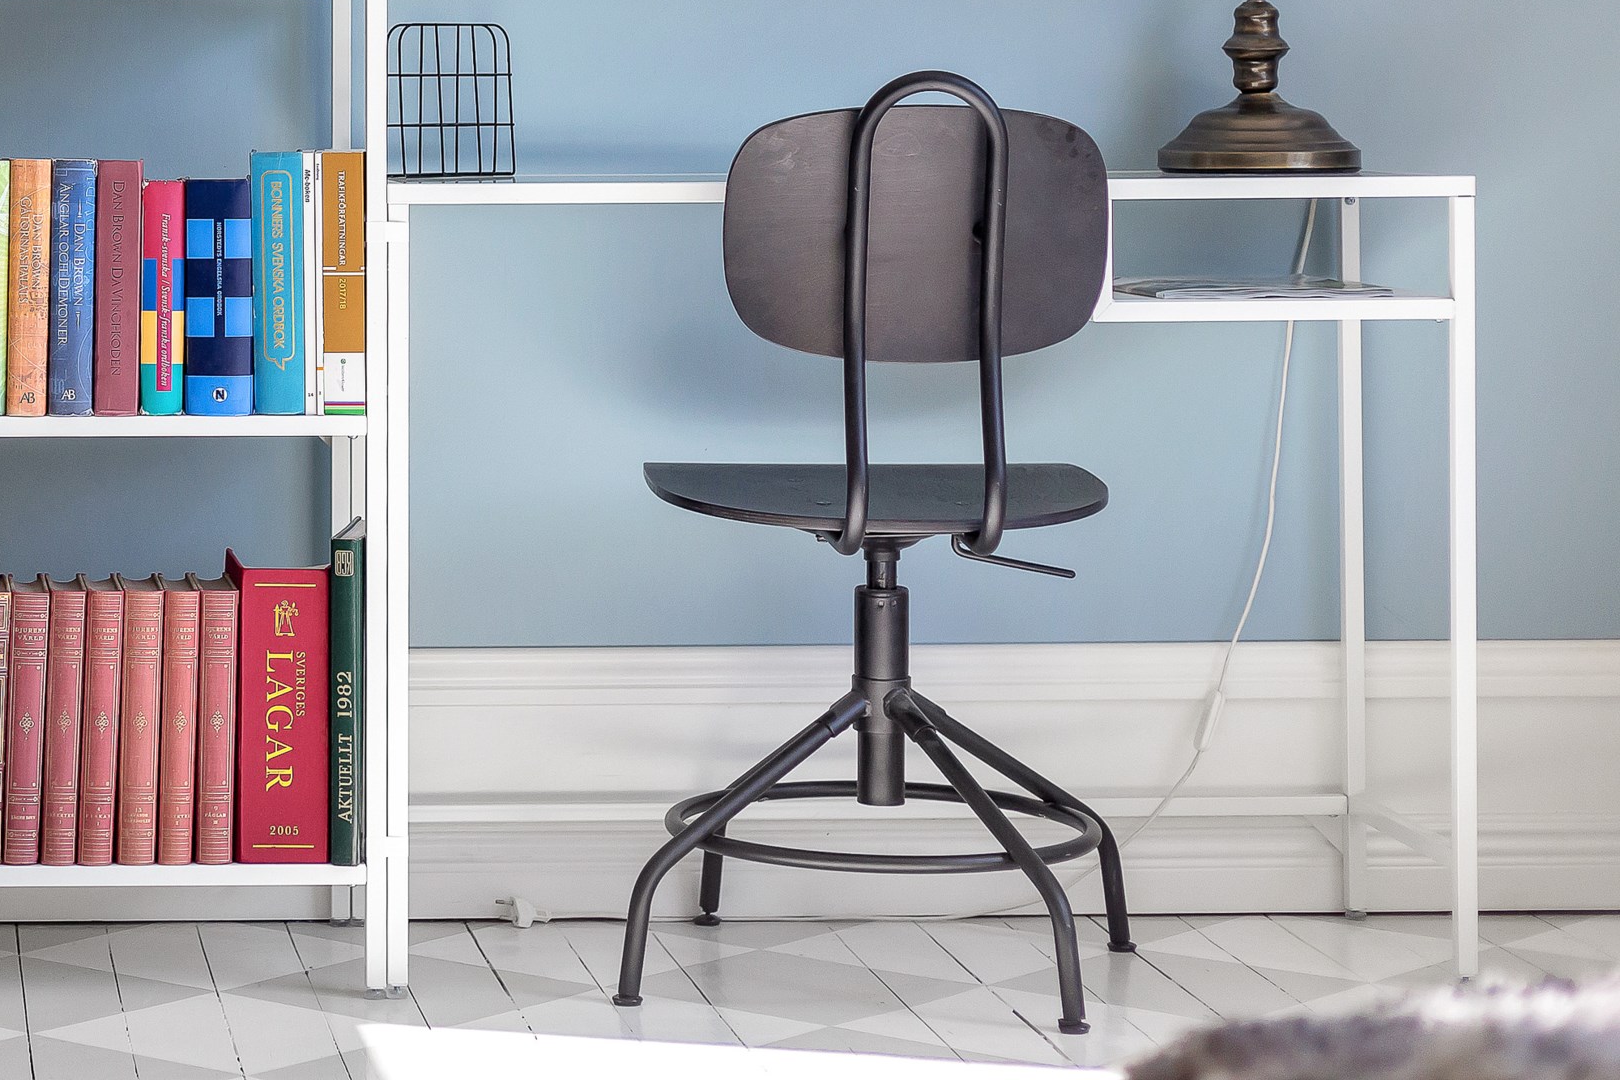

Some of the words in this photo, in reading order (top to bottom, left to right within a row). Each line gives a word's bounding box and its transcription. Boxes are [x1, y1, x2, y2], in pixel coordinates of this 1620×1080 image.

[59, 182, 76, 237] ÄNGLAR
[270, 181, 284, 238] BONNIERS
[304, 169, 312, 203] Mc-boken
[32, 213, 43, 242] DAN
[73, 222, 86, 253] DAN
[338, 170, 349, 266] TRAFIKFÖRFATTNINGAR
[31, 245, 43, 289] BROWN
[58, 242, 70, 272] OCH
[159, 213, 171, 278] Fransk-svenska
[271, 242, 285, 294] SVENSKA
[73, 257, 86, 306] BROWN
[338, 278, 347, 309] 2017/18
[57, 276, 70, 345] DEMONER
[158, 286, 171, 349] Svensk-franska
[272, 296, 286, 349] ORDBOK
[160, 350, 170, 387] ordboken
[295, 651, 306, 717] SVERIGES
[336, 671, 353, 718] 1982
[264, 649, 294, 792] LAGAR
[337, 733, 353, 825] AKTUELLT
[269, 826, 300, 836] 2005
